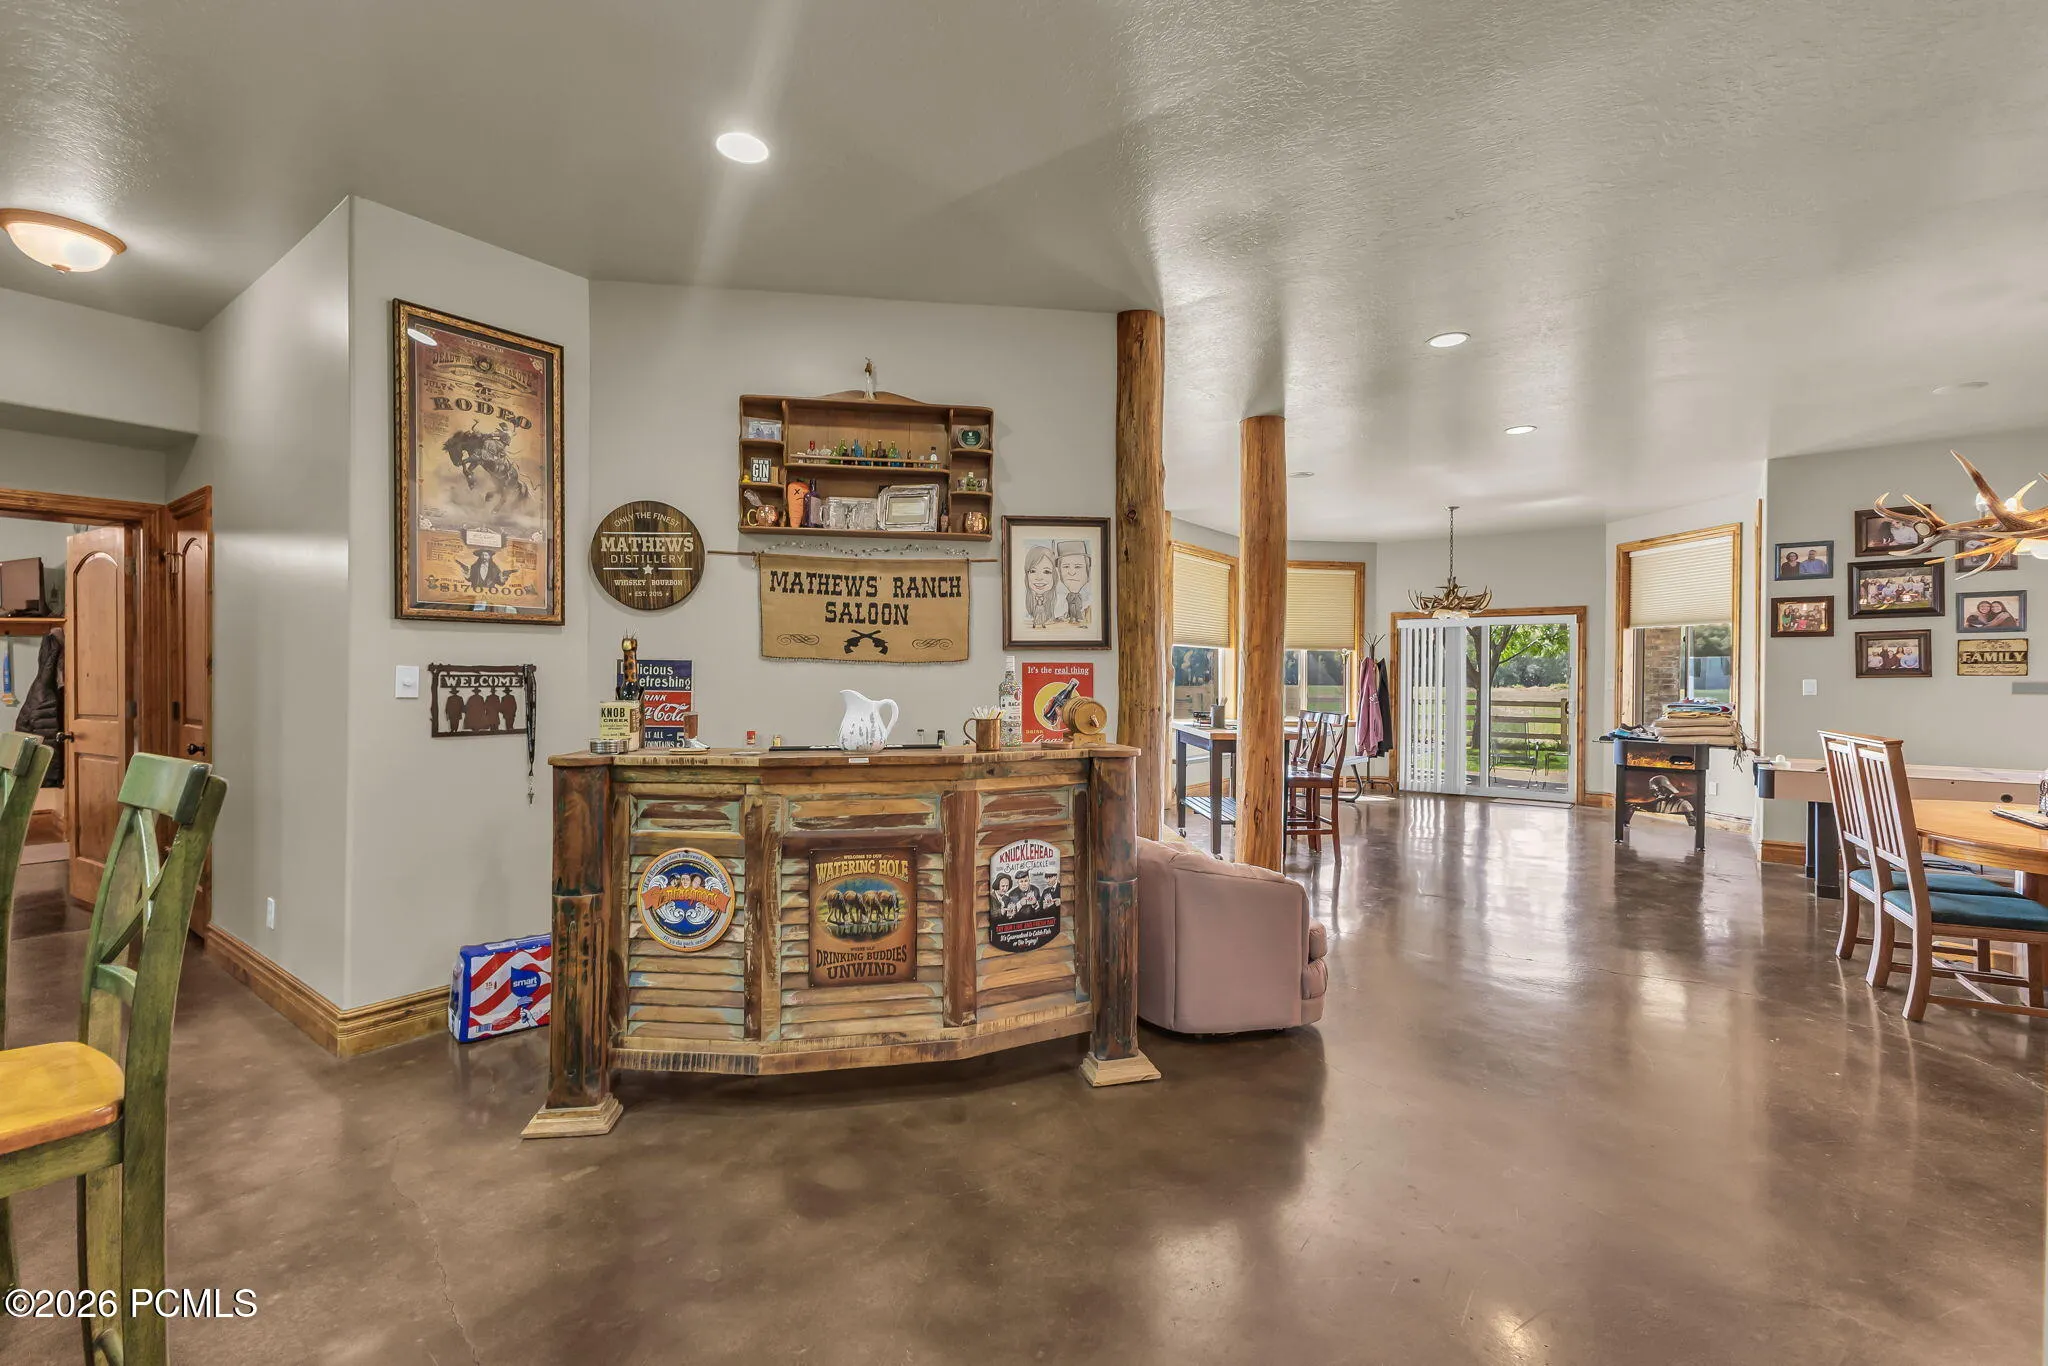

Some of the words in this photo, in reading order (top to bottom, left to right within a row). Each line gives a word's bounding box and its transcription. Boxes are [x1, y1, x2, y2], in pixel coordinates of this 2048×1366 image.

[430, 396, 532, 430] RODEO
[752, 464, 769, 478] GIN
[614, 513, 634, 527] ONLY
[635, 511, 651, 519] THE
[653, 512, 680, 527] FINEST
[600, 537, 694, 552] MATHEWS
[610, 554, 685, 564] DISTILLERY
[893, 575, 962, 598] RANCH
[825, 601, 910, 626] SALOON
[1961, 651, 2026, 662] FAMILY
[1027, 666, 1039, 674] It's
[1040, 666, 1052, 674] the
[1054, 666, 1069, 675] real
[1070, 666, 1089, 676] thing
[444, 676, 520, 687] WELCOME
[639, 676, 691, 690] efreshing
[601, 707, 625, 718] KNOB
[999, 843, 1054, 863] KNUCKLEHEAD
[815, 859, 875, 885] WATERING
[878, 859, 909, 882] HOLE
[816, 949, 864, 968] DRINKING
[866, 944, 907, 963] BUDDIES
[827, 962, 897, 980] UNWIND
[513, 976, 538, 988] smart
